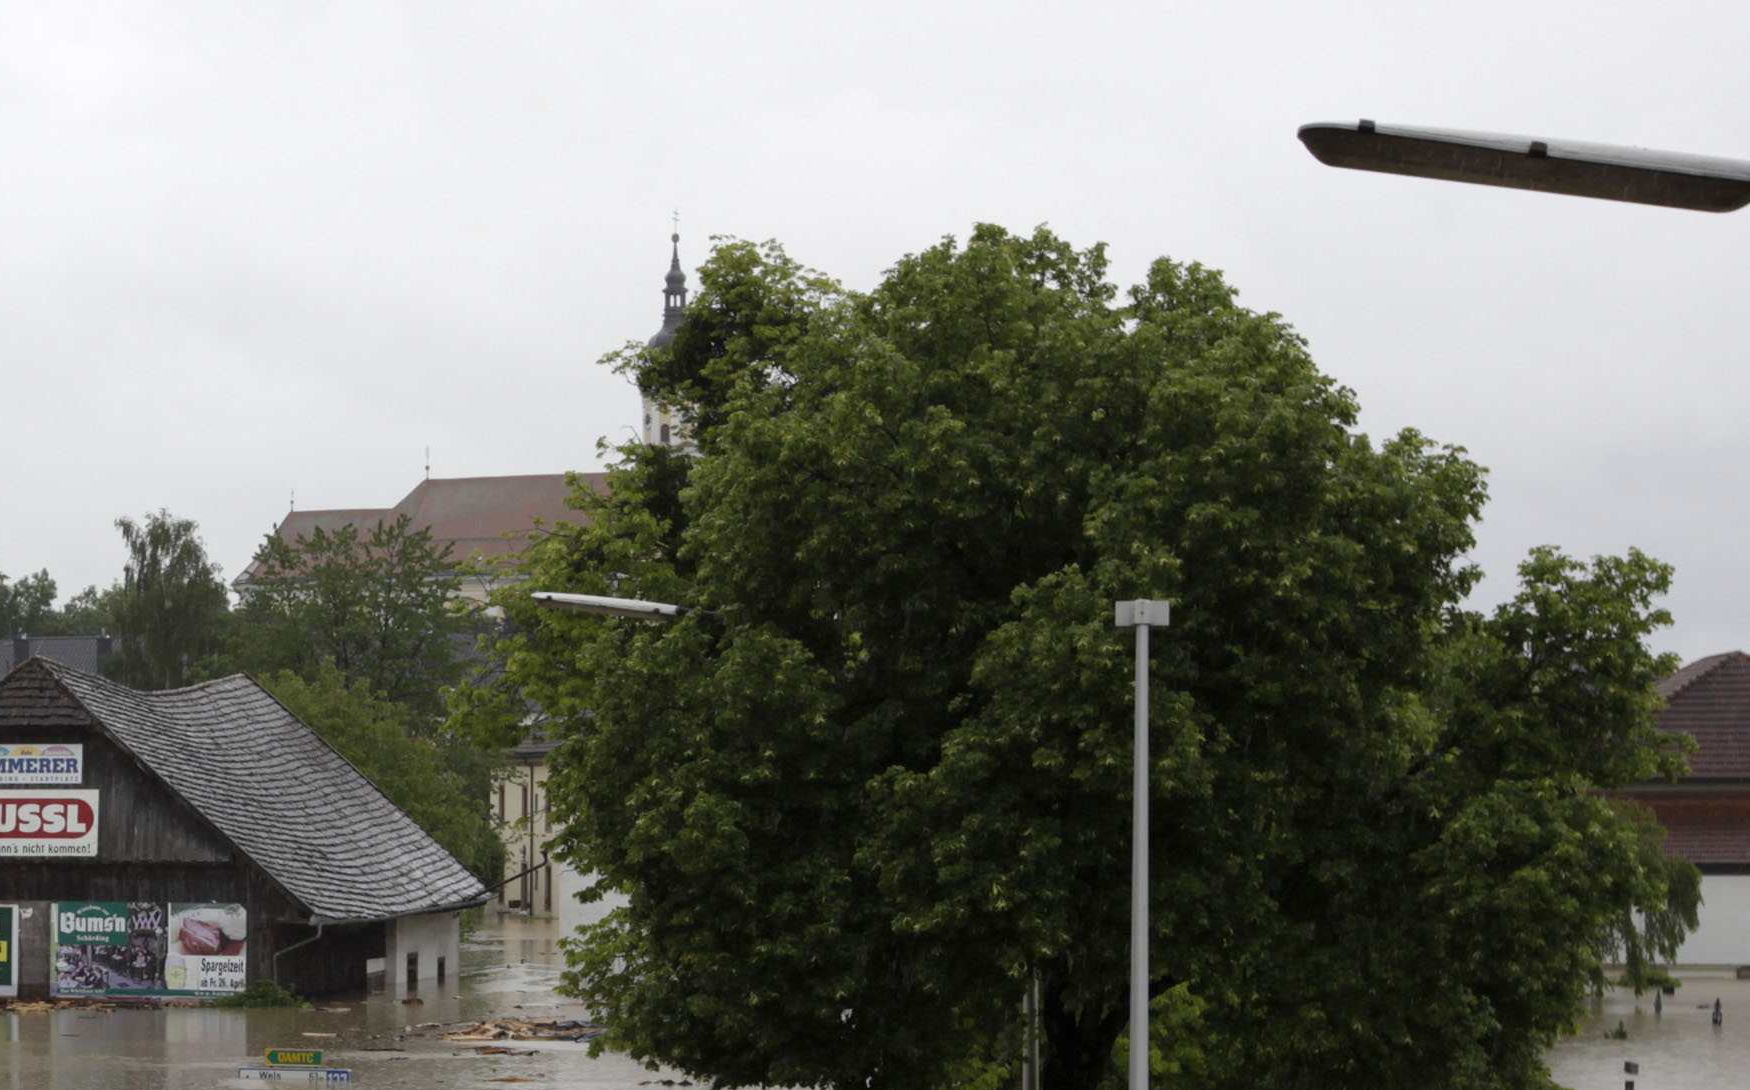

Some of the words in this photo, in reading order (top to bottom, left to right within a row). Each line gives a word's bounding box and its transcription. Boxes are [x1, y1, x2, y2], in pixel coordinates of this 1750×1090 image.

[22, 843, 45, 854] nicht
[48, 844, 91, 854] kommen!
[201, 957, 244, 975] Spargelzeit
[259, 1071, 282, 1081] Wels
